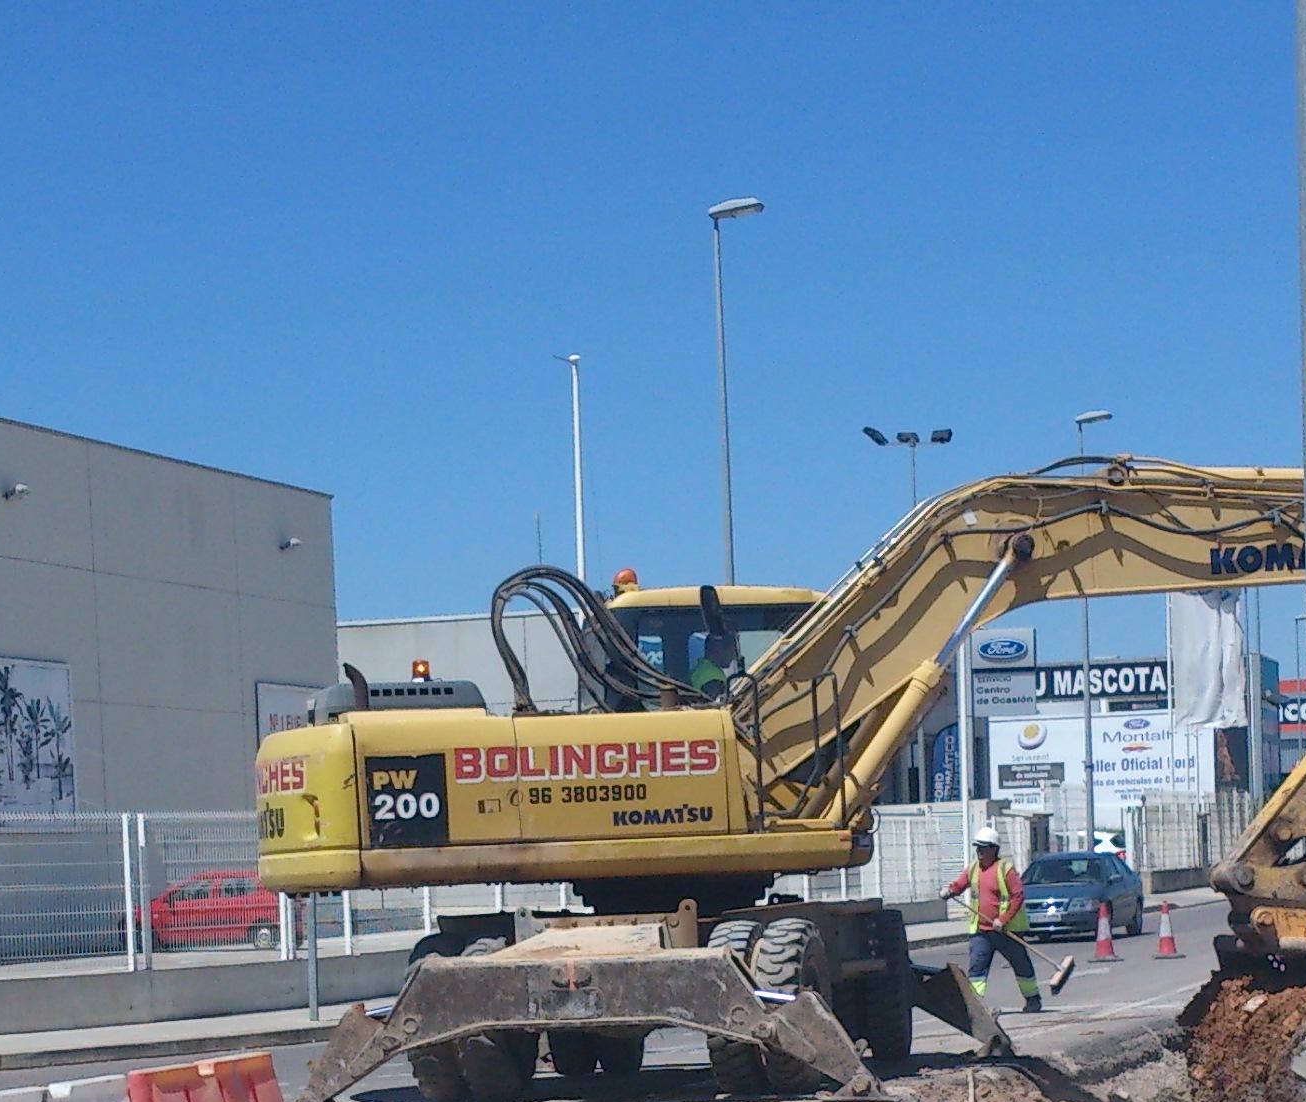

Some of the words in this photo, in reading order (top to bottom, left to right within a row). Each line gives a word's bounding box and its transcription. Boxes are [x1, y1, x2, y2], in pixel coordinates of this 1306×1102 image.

[976, 686, 1011, 695] Centro
[1054, 666, 1167, 696] MASCOTA
[976, 695, 989, 705] de
[991, 694, 1033, 705] Ocasión
[454, 739, 720, 783] BOLINCHES
[1121, 756, 1163, 771] Oficial
[373, 770, 417, 790] PW
[529, 787, 552, 804] 96
[561, 783, 647, 803] 3803900
[374, 792, 441, 821] 200
[613, 804, 713, 826] KOMATSU
